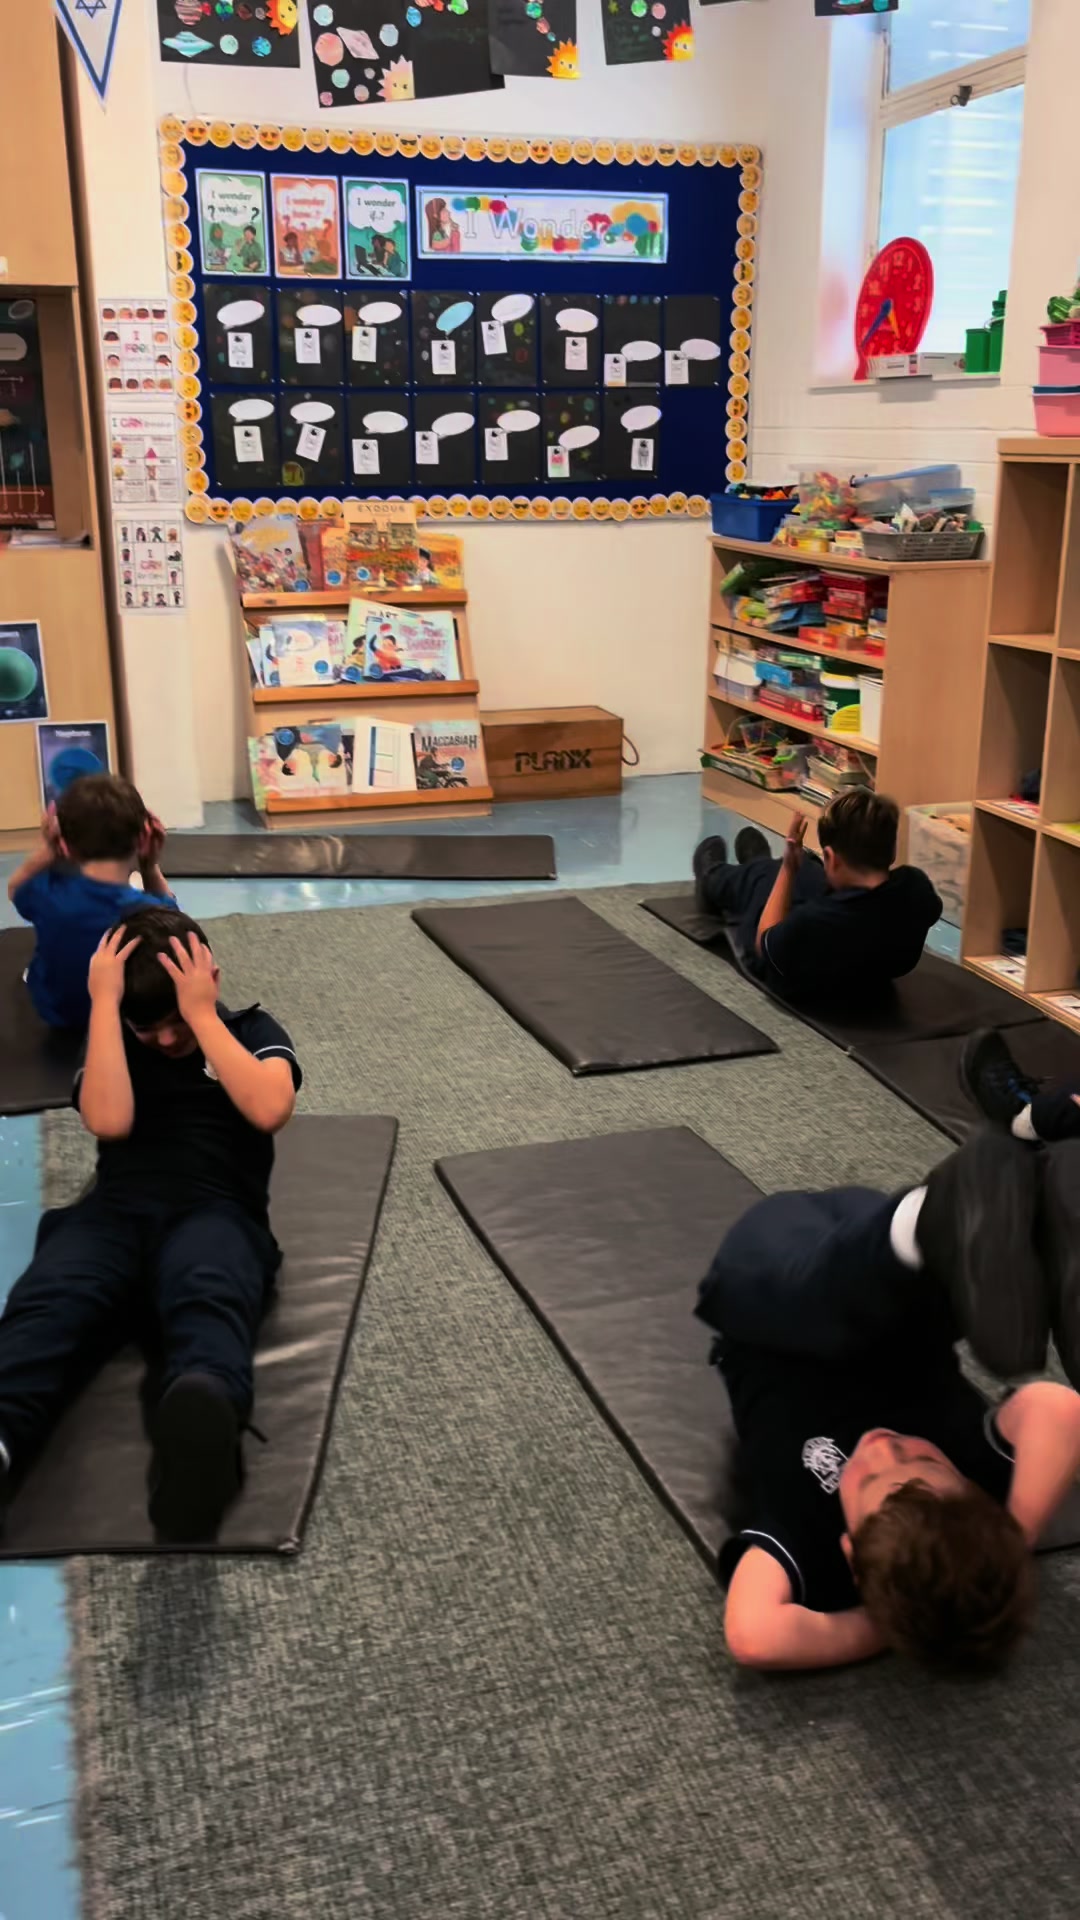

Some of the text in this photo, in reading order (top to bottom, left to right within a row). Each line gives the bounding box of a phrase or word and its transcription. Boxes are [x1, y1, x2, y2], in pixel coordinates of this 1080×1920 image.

[364, 198, 396, 207] wonder
[488, 207, 613, 240] Wonder
[357, 504, 406, 513] EXODUS
